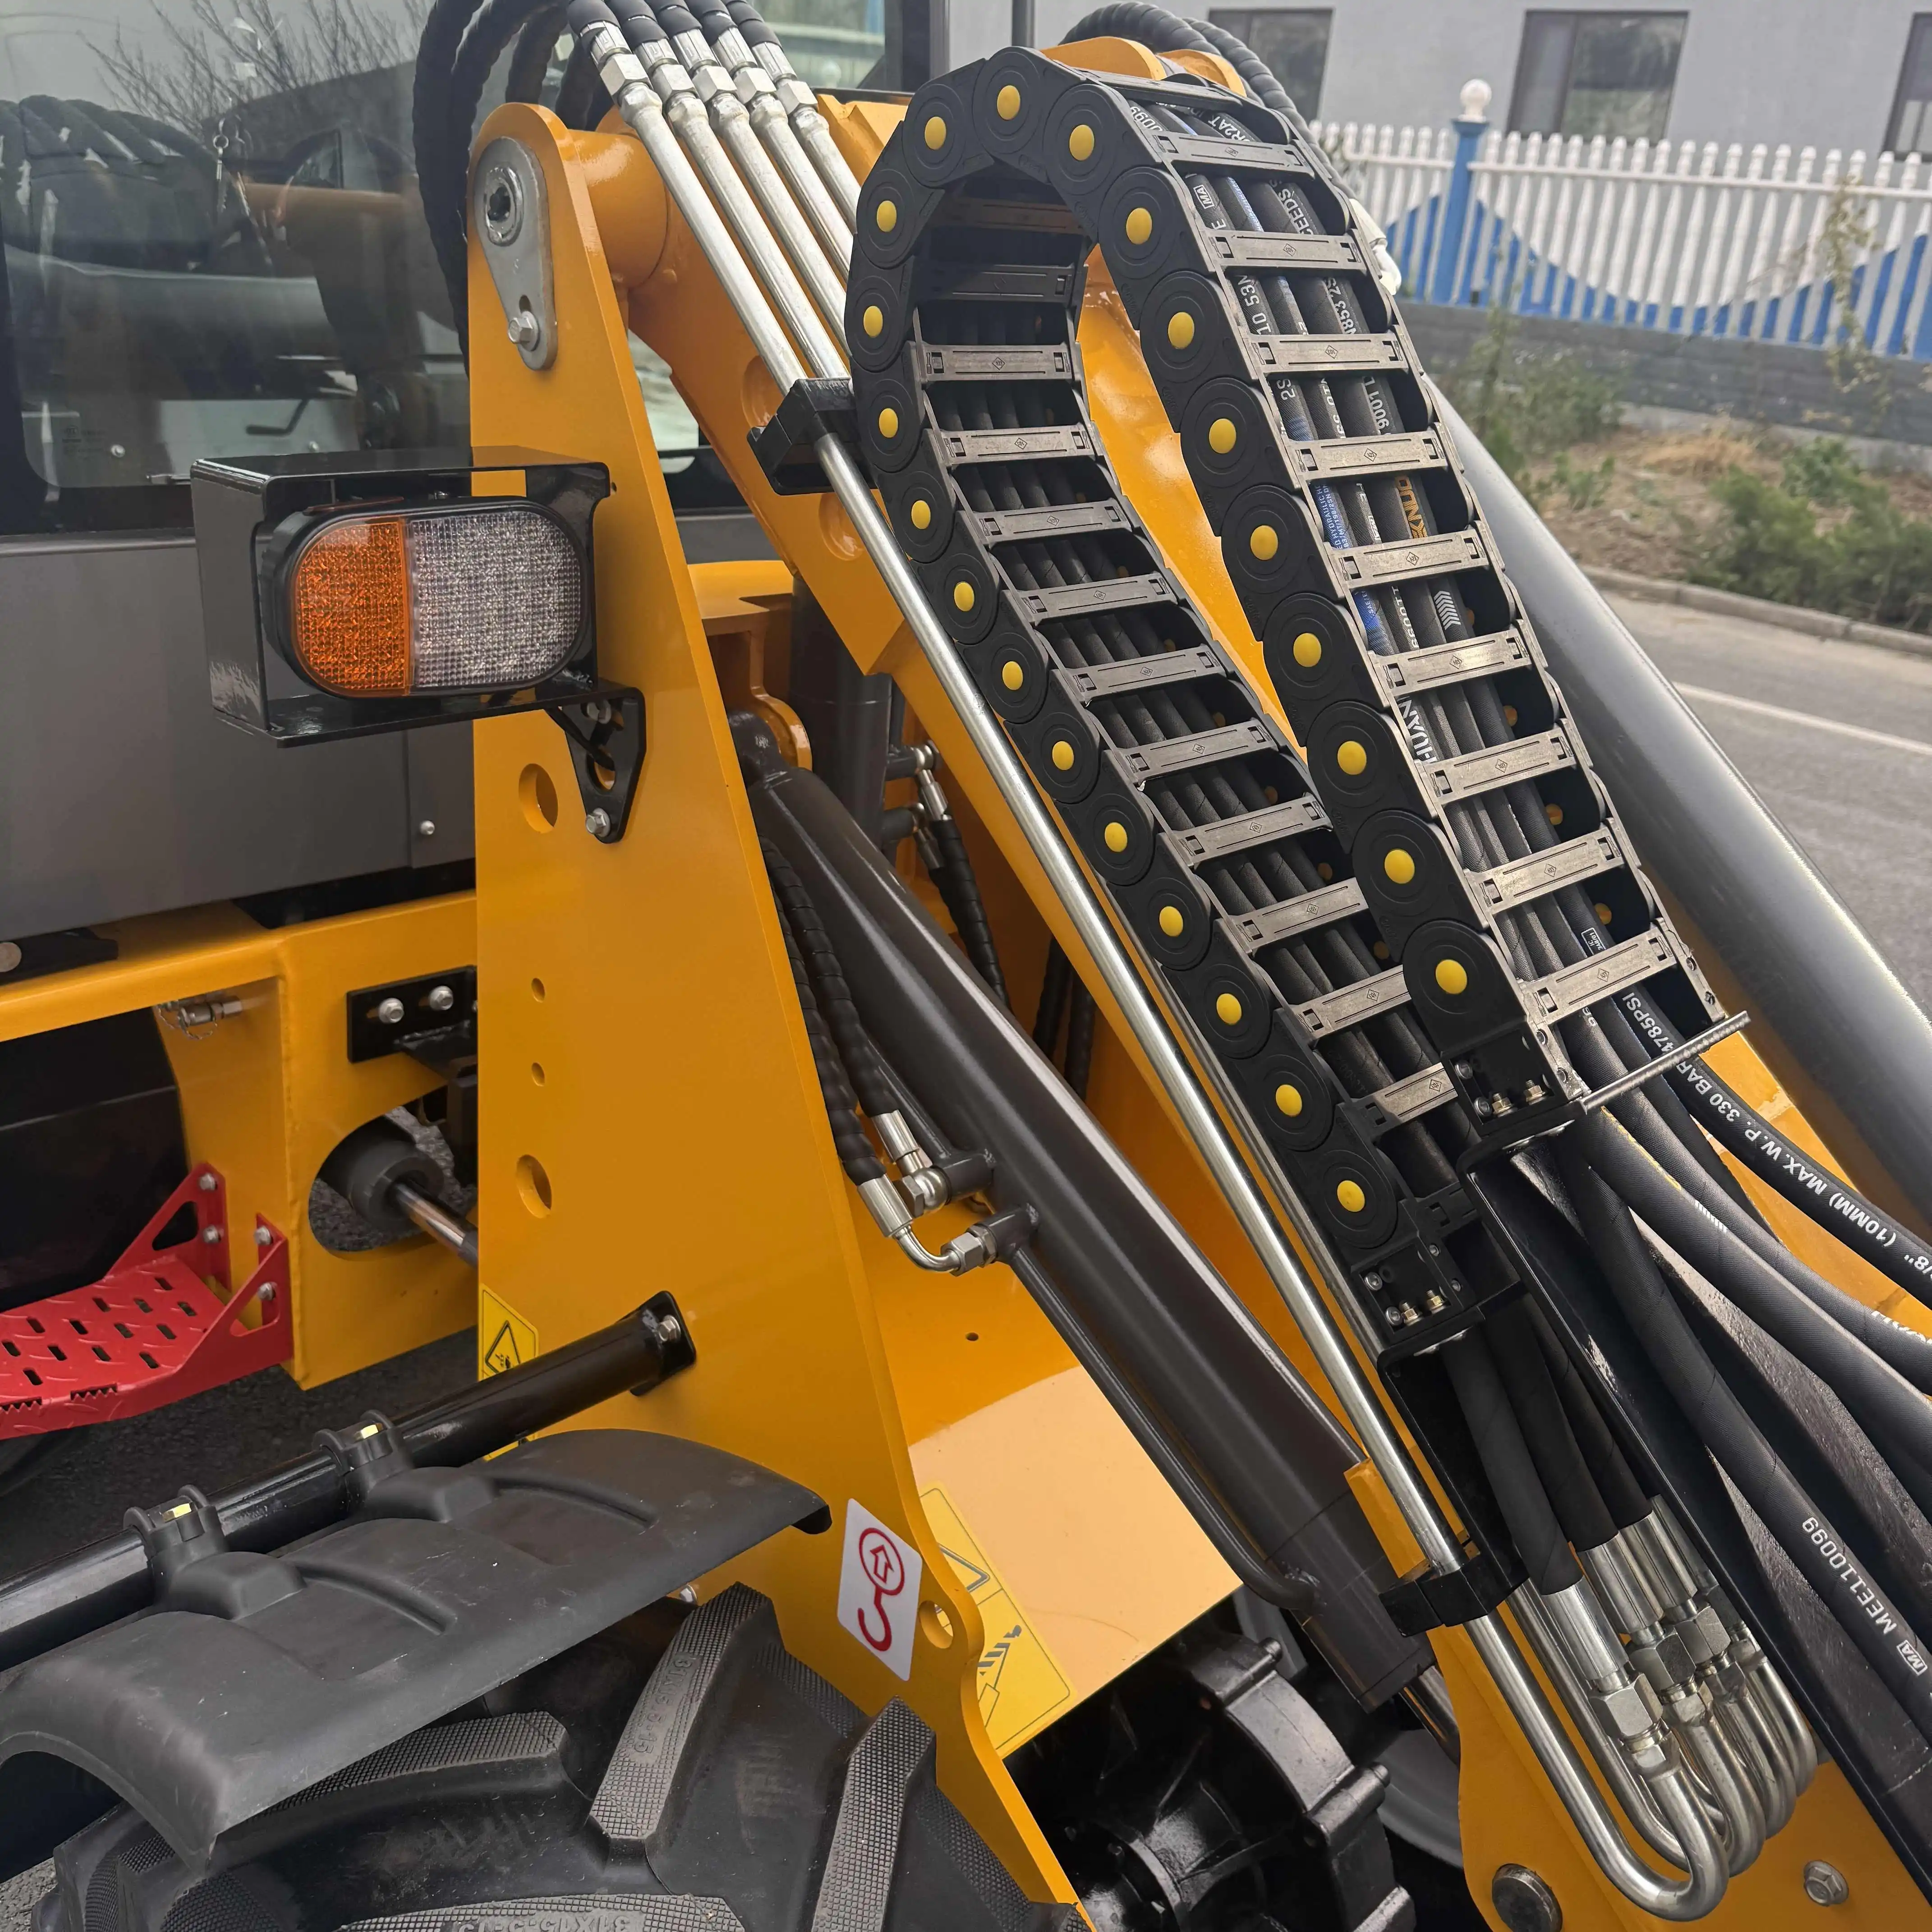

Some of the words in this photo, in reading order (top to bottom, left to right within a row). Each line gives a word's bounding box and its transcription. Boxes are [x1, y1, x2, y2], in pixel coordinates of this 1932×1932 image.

[1208, 116, 1250, 142] R2AT
[1319, 495, 1340, 538] HYDRAULIC
[1622, 993, 1674, 1052] 4785PSI
[1710, 1094, 1740, 1122] 330
[1829, 1193, 1896, 1246] (10MM)
[1802, 1517, 1897, 1634] MEE110099
[1899, 1642, 1926, 1672] MA
